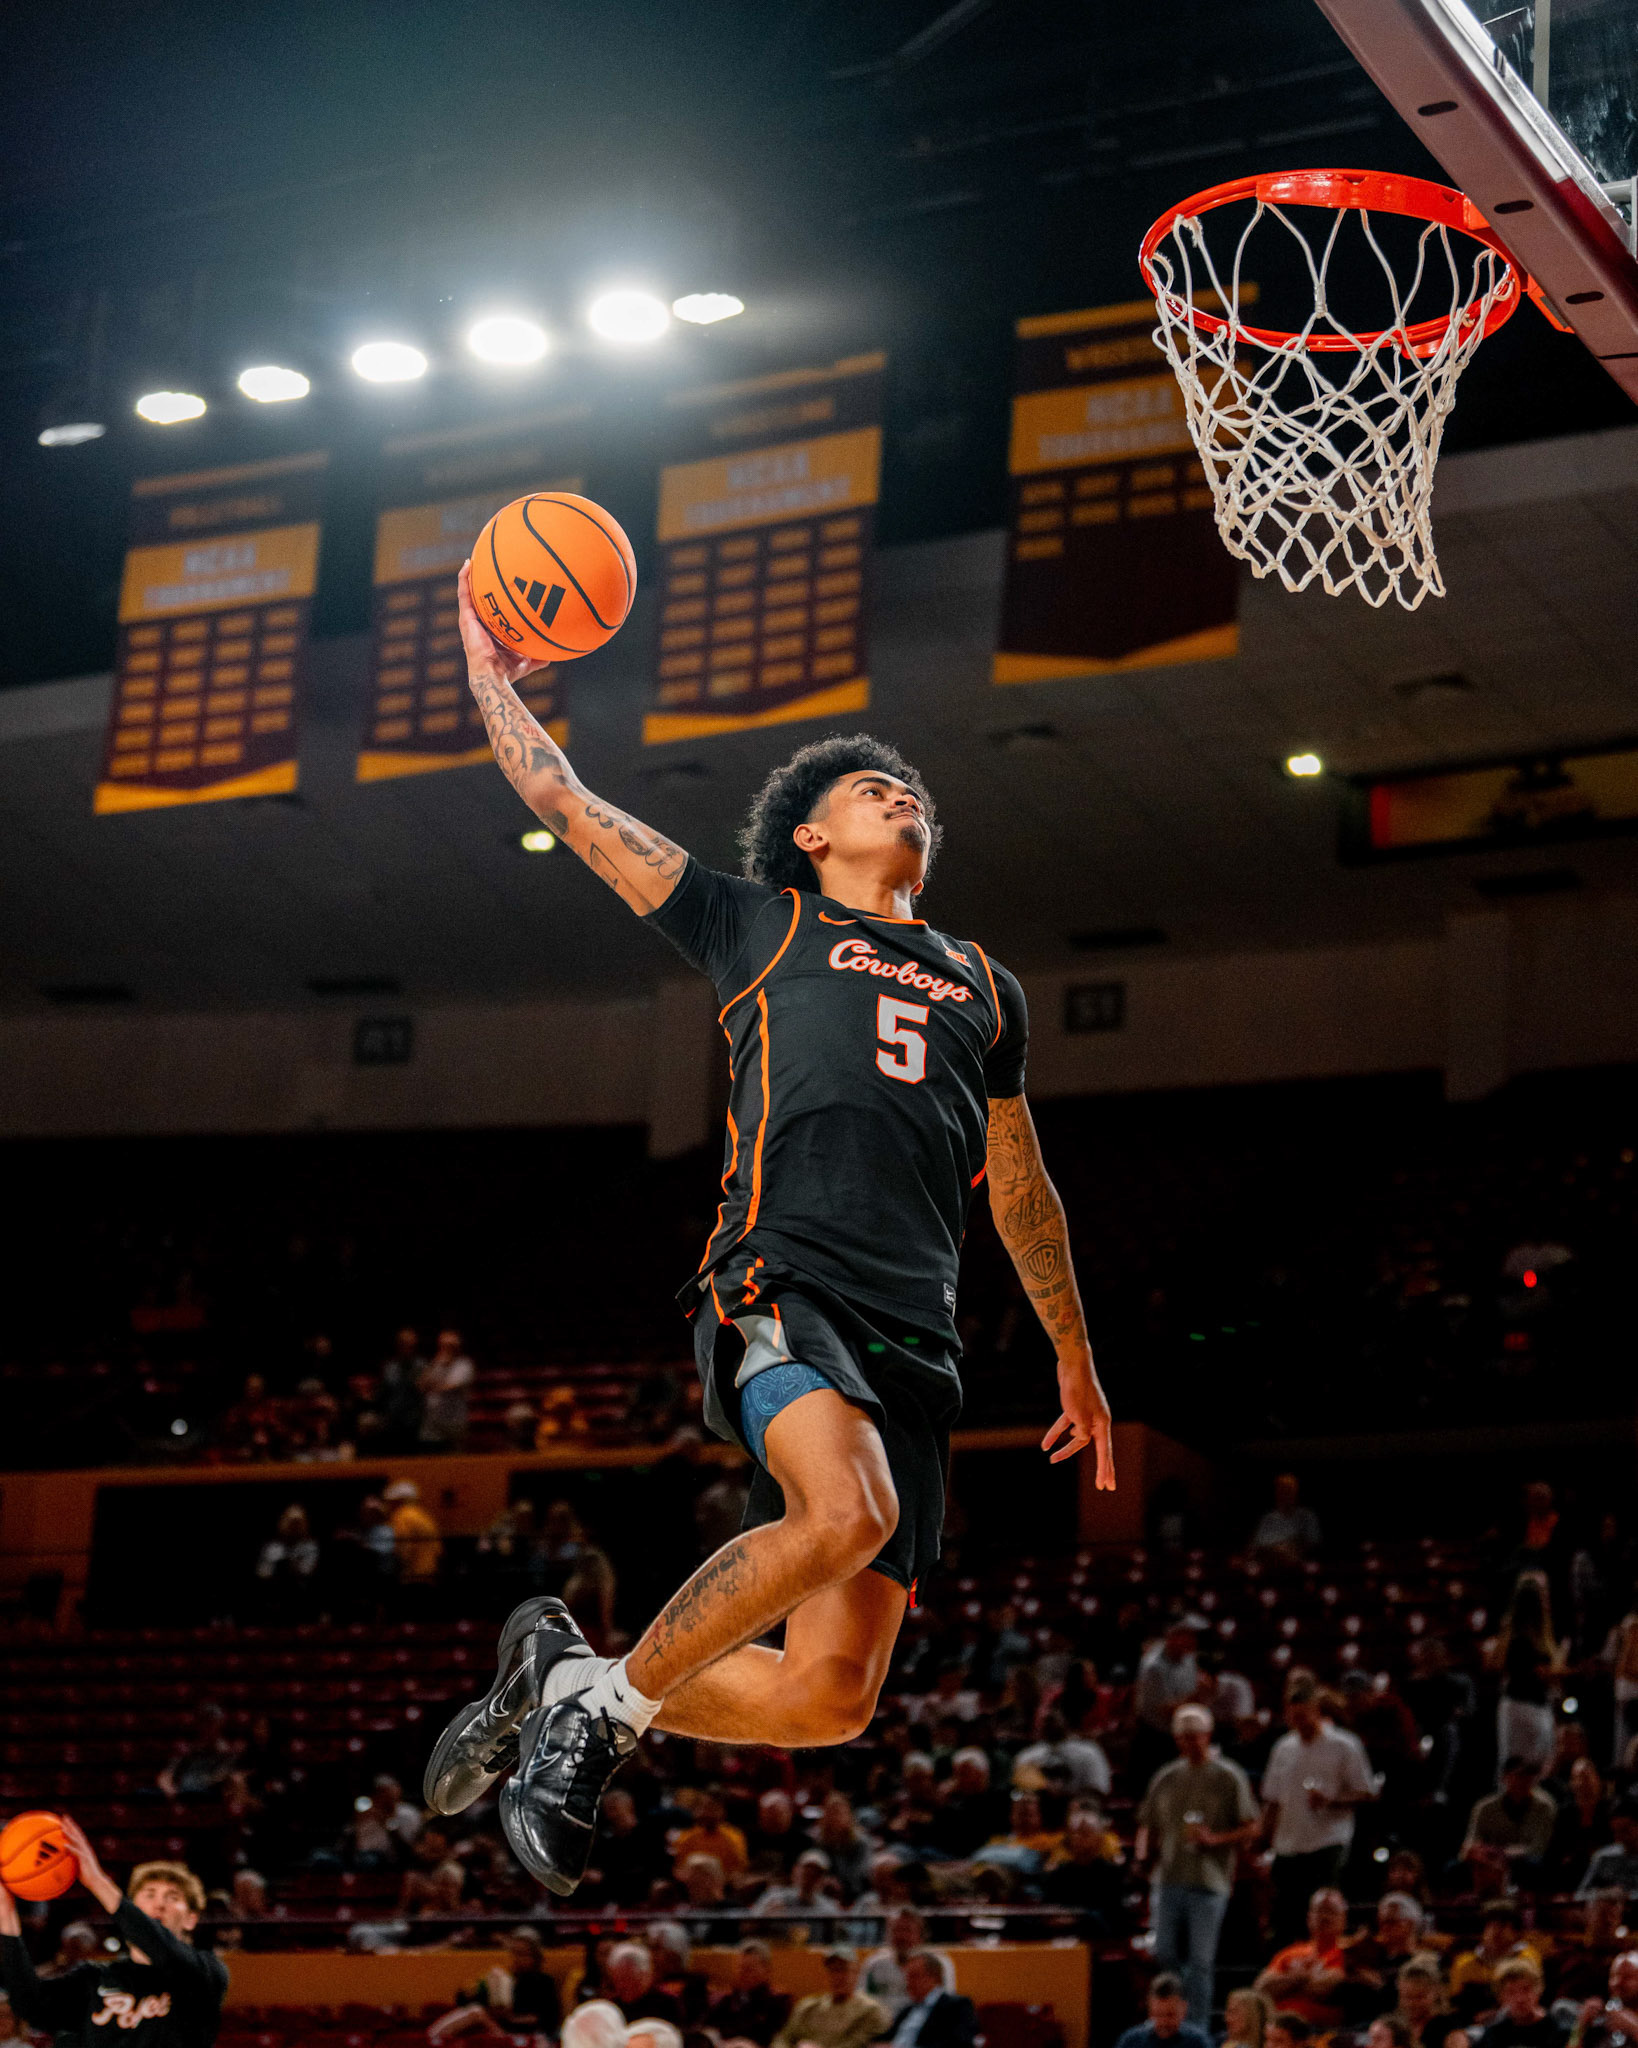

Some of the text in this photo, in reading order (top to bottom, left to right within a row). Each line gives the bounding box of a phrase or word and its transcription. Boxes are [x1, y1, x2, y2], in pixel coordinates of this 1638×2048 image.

[484, 592, 524, 642] PRO
[828, 938, 974, 1003] Cowboys
[875, 993, 930, 1085] 5
